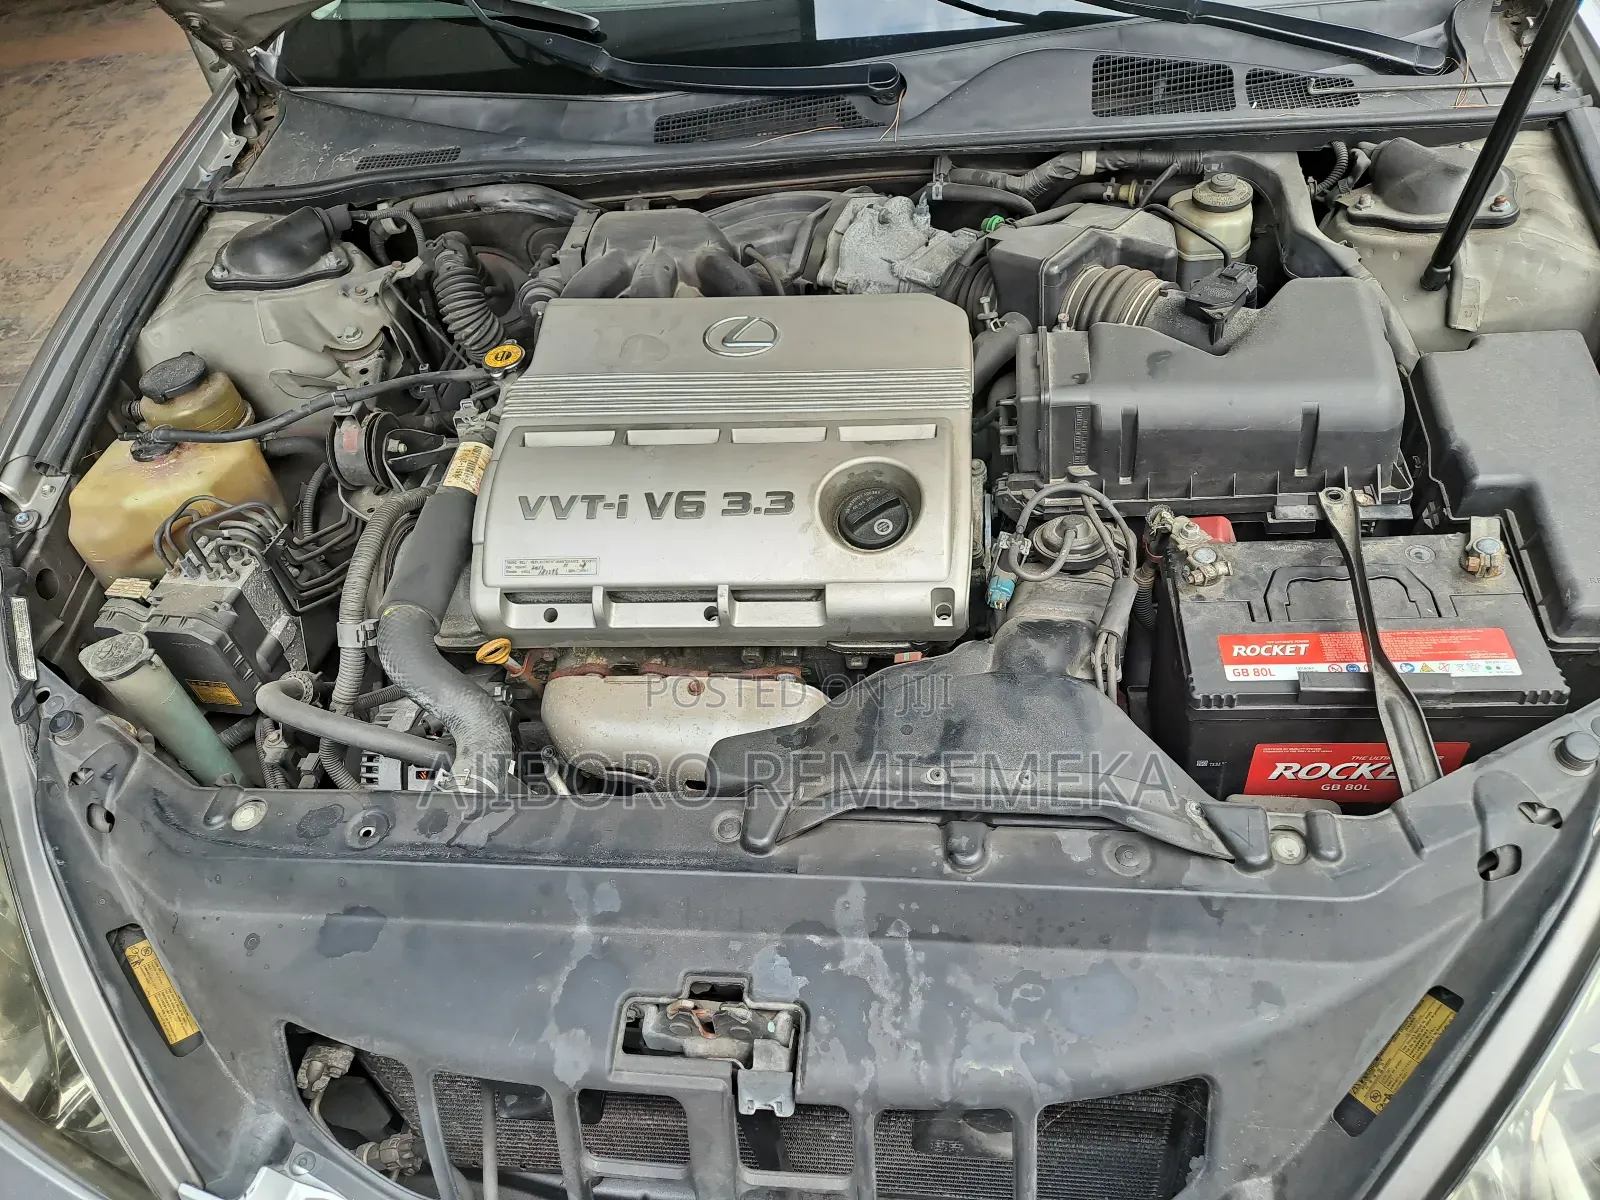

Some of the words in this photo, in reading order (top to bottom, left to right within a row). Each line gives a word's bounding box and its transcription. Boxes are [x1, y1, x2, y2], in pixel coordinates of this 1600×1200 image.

[518, 494, 630, 520] VVT-i
[644, 490, 706, 520] V6
[721, 490, 796, 516] 3.3
[1232, 643, 1310, 656] ROCKET
[1232, 668, 1250, 677] GB
[1253, 667, 1276, 677] 80L
[1267, 762, 1397, 780] ROCKE
[1320, 783, 1340, 791] GB
[1344, 783, 1371, 791] 80L
